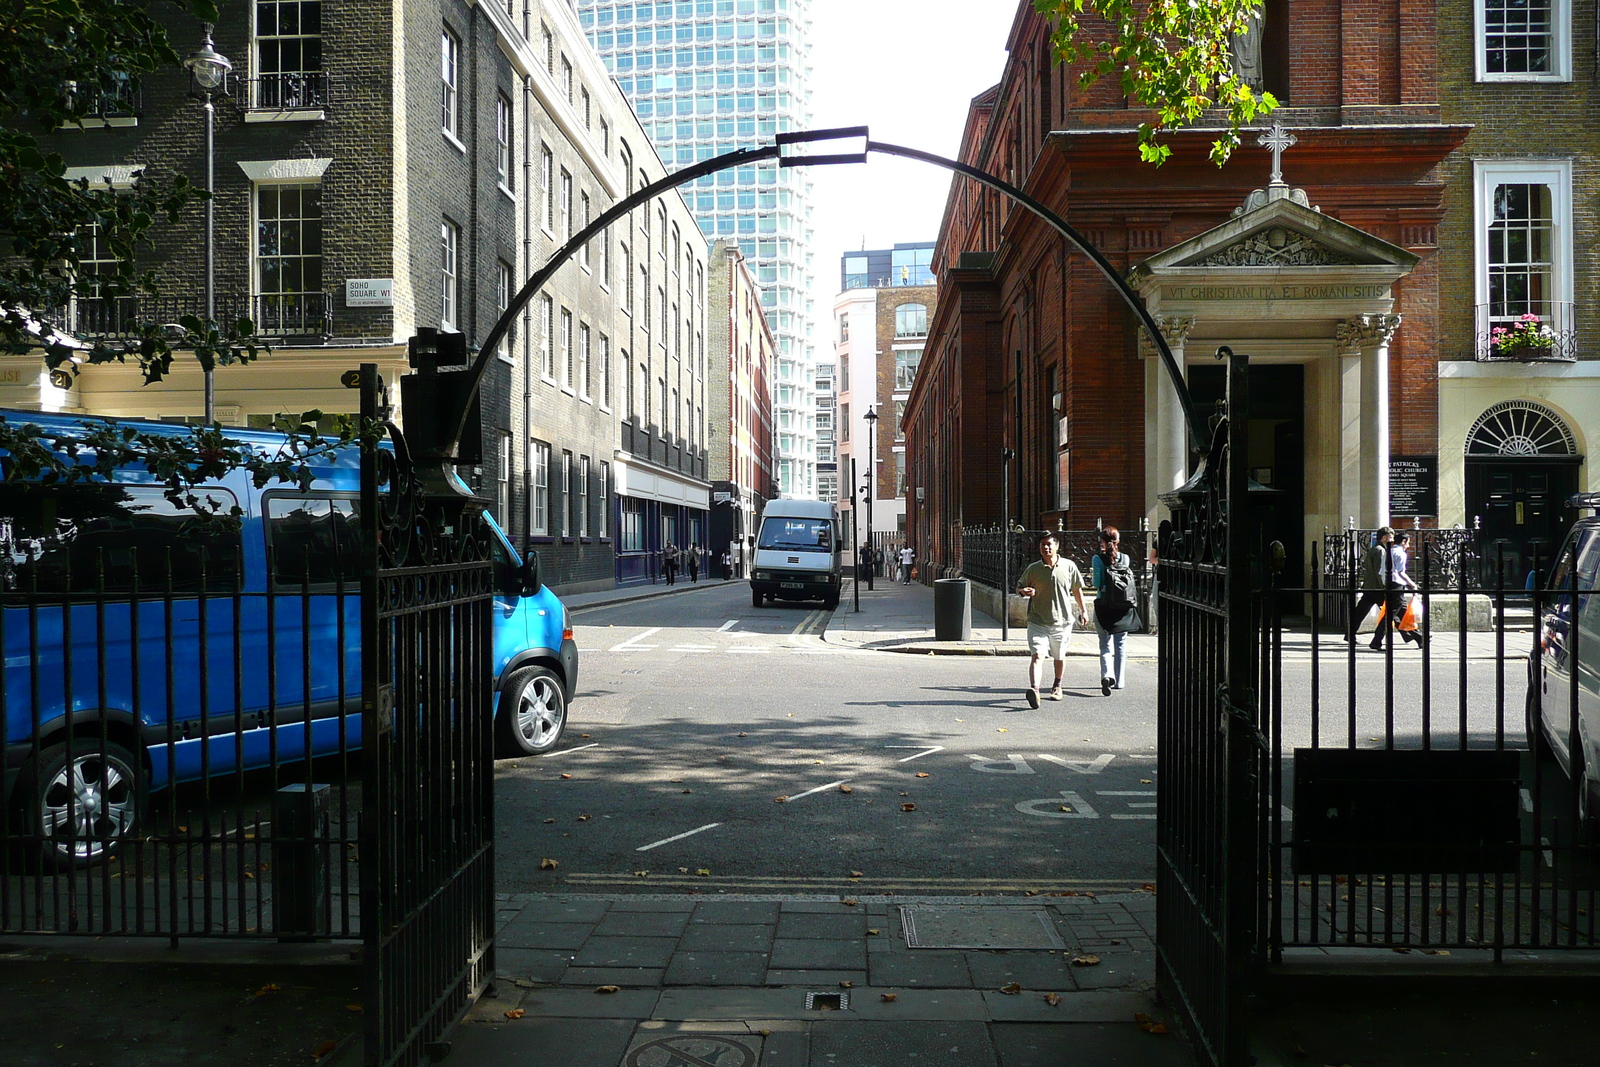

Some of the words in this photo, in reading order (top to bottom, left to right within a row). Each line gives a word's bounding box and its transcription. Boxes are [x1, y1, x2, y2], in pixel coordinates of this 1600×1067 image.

[1170, 287, 1185, 298] VT
[1191, 287, 1254, 298] CHRISTIANI
[1260, 287, 1276, 298] ITA
[1282, 286, 1298, 298] ET
[1304, 286, 1349, 298] ROMANI
[1354, 285, 1384, 297] SITIS
[55, 373, 67, 387] 21
[350, 373, 360, 386] 2
